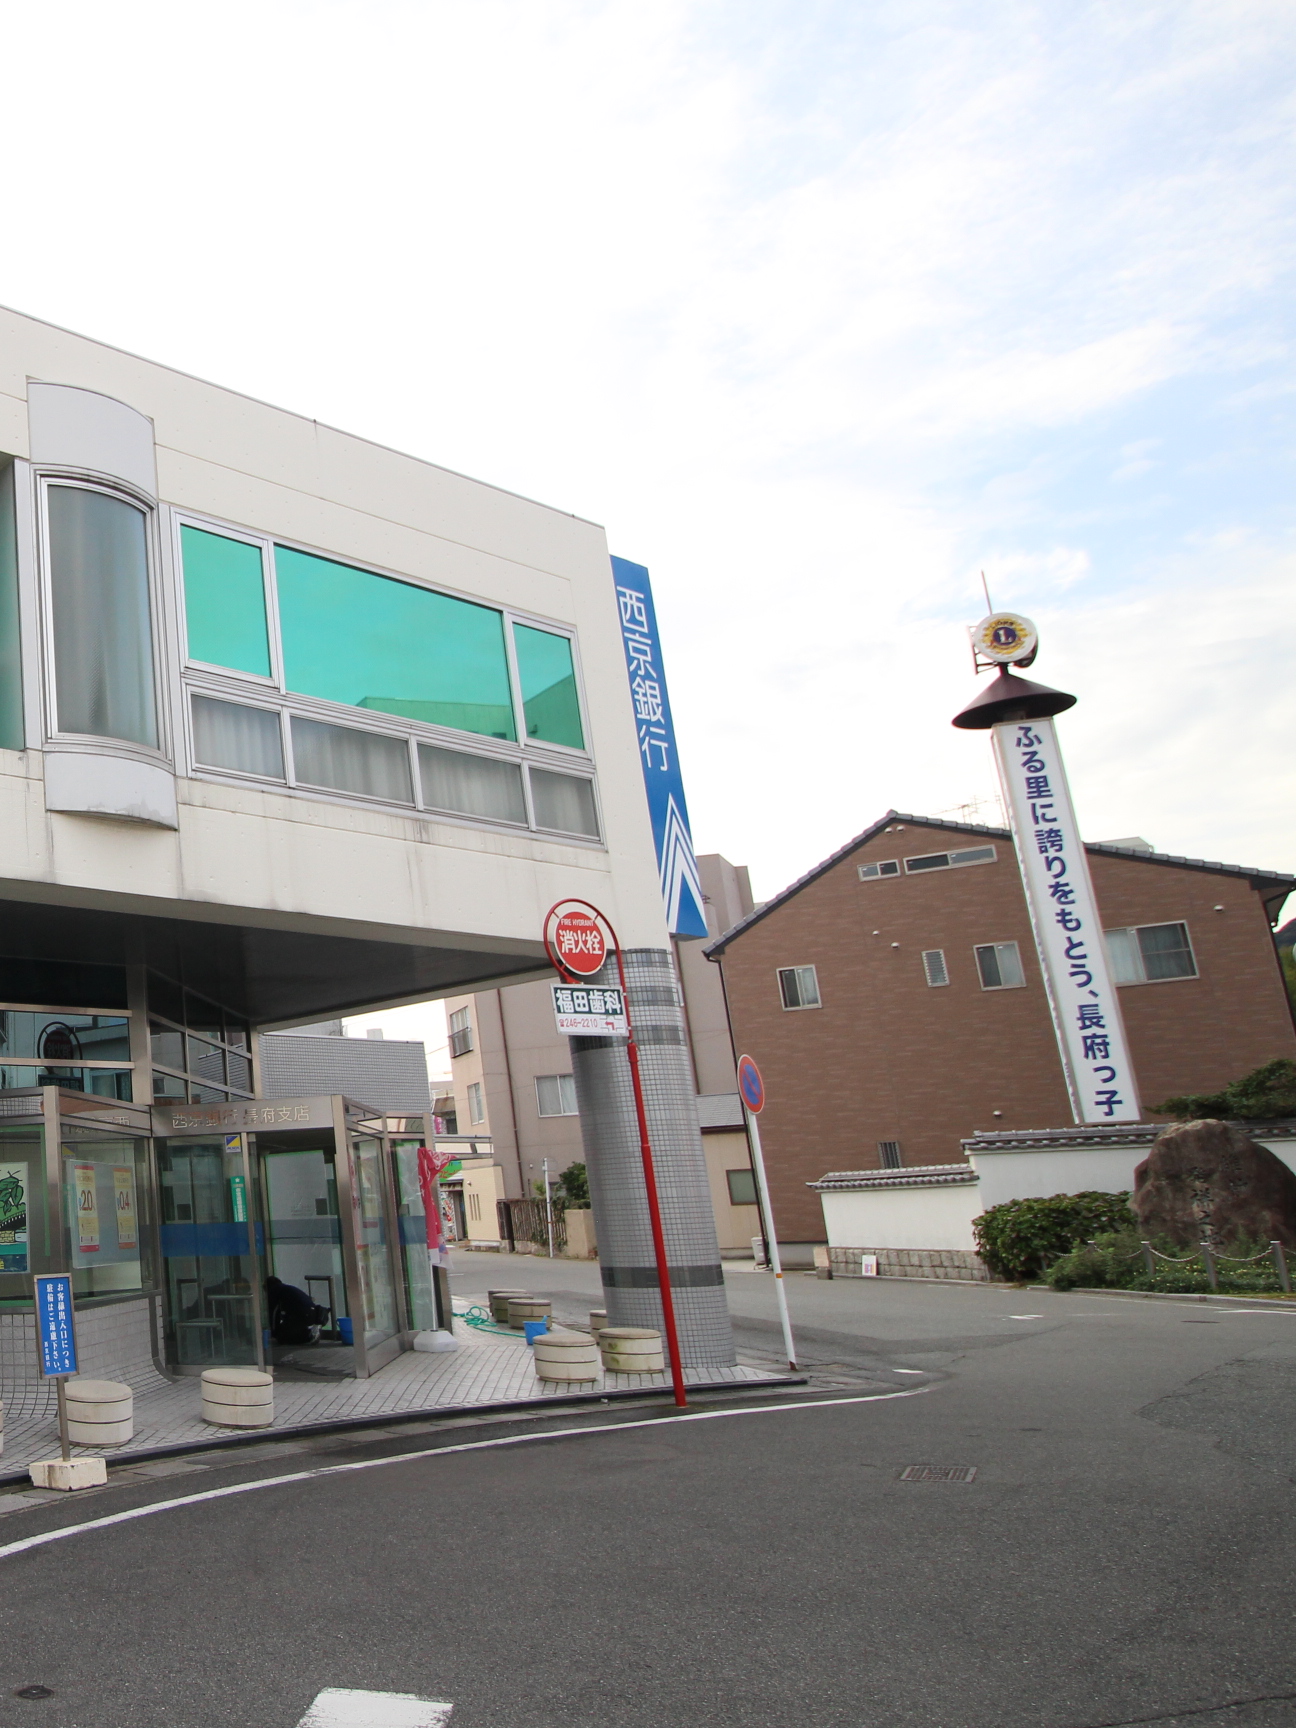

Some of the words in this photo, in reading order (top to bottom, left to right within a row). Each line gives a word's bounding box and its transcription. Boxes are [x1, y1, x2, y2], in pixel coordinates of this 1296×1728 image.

[616, 585, 669, 772] 西京銀行
[561, 918, 572, 926] FIRE
[572, 919, 594, 927] HYDRANT
[559, 929, 603, 955] 消火栓
[556, 989, 622, 1014] 福田歯科
[242, 1105, 311, 1125] 長府支店
